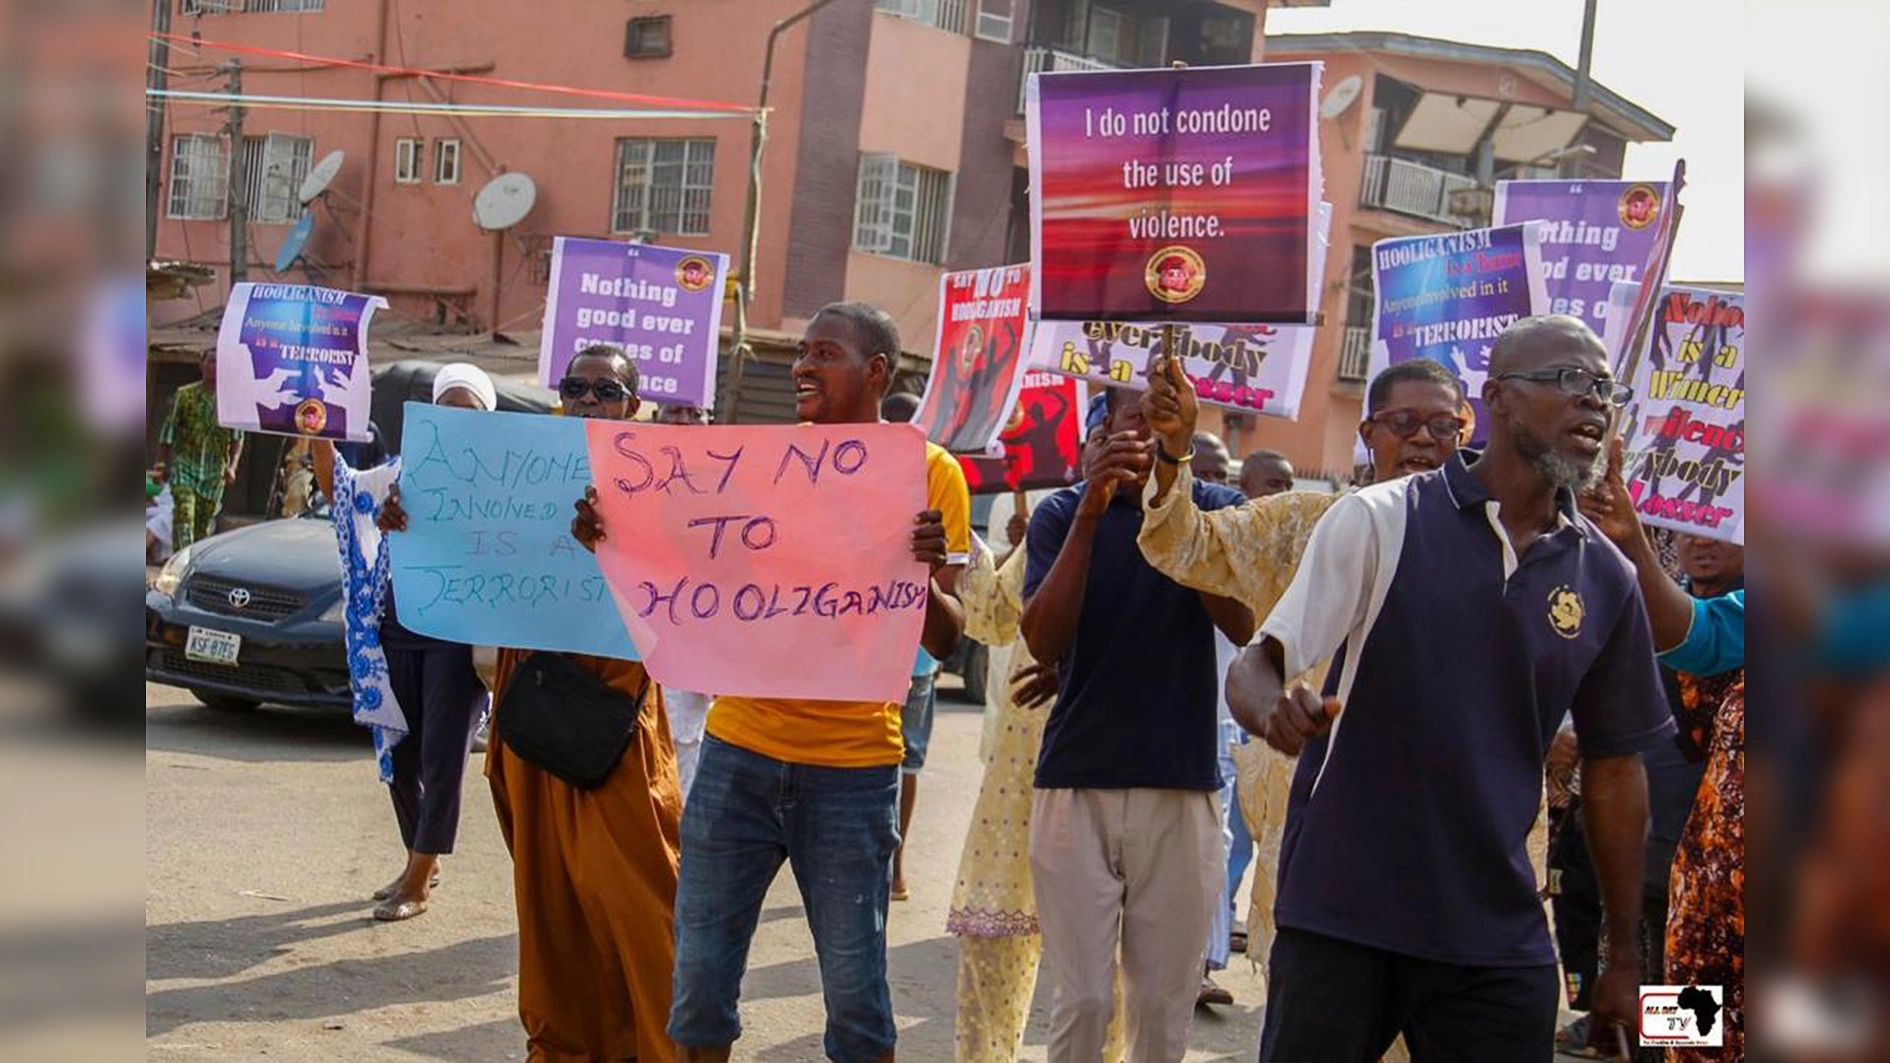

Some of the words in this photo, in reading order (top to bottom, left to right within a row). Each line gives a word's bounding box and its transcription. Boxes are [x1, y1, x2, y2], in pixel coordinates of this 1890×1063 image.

[1085, 108, 1092, 137] I
[1099, 107, 1126, 137] do
[1133, 107, 1169, 135] not
[1176, 103, 1271, 134] condone
[1123, 159, 1158, 188] the
[1165, 163, 1204, 186] use
[1211, 155, 1233, 186] of
[1129, 208, 1225, 238] violence.
[1538, 219, 1620, 252] othing
[1379, 230, 1493, 271] HOOLIGANISM
[1541, 256, 1569, 280] od
[1576, 263, 1637, 283] ever
[252, 284, 347, 305] HOOLIGANISM
[580, 272, 678, 307] Nothing
[1480, 280, 1494, 297] in
[1497, 277, 1509, 294] it
[576, 307, 636, 329] good
[642, 313, 695, 335] ever
[1414, 314, 1519, 347] TERRORIST
[280, 343, 354, 366] TERRORIST
[659, 343, 685, 364] of
[1059, 341, 1092, 375] is
[1109, 358, 1133, 384] a
[1082, 320, 1268, 379] everbody
[1675, 333, 1705, 365] is
[1713, 344, 1738, 369] a
[406, 419, 592, 489] ANYONE
[614, 432, 745, 498] SAY
[773, 437, 869, 486] NO
[464, 529, 518, 556] IS
[549, 534, 576, 561] A
[687, 515, 777, 560] TO
[638, 575, 928, 626] HOOLIGANISM
